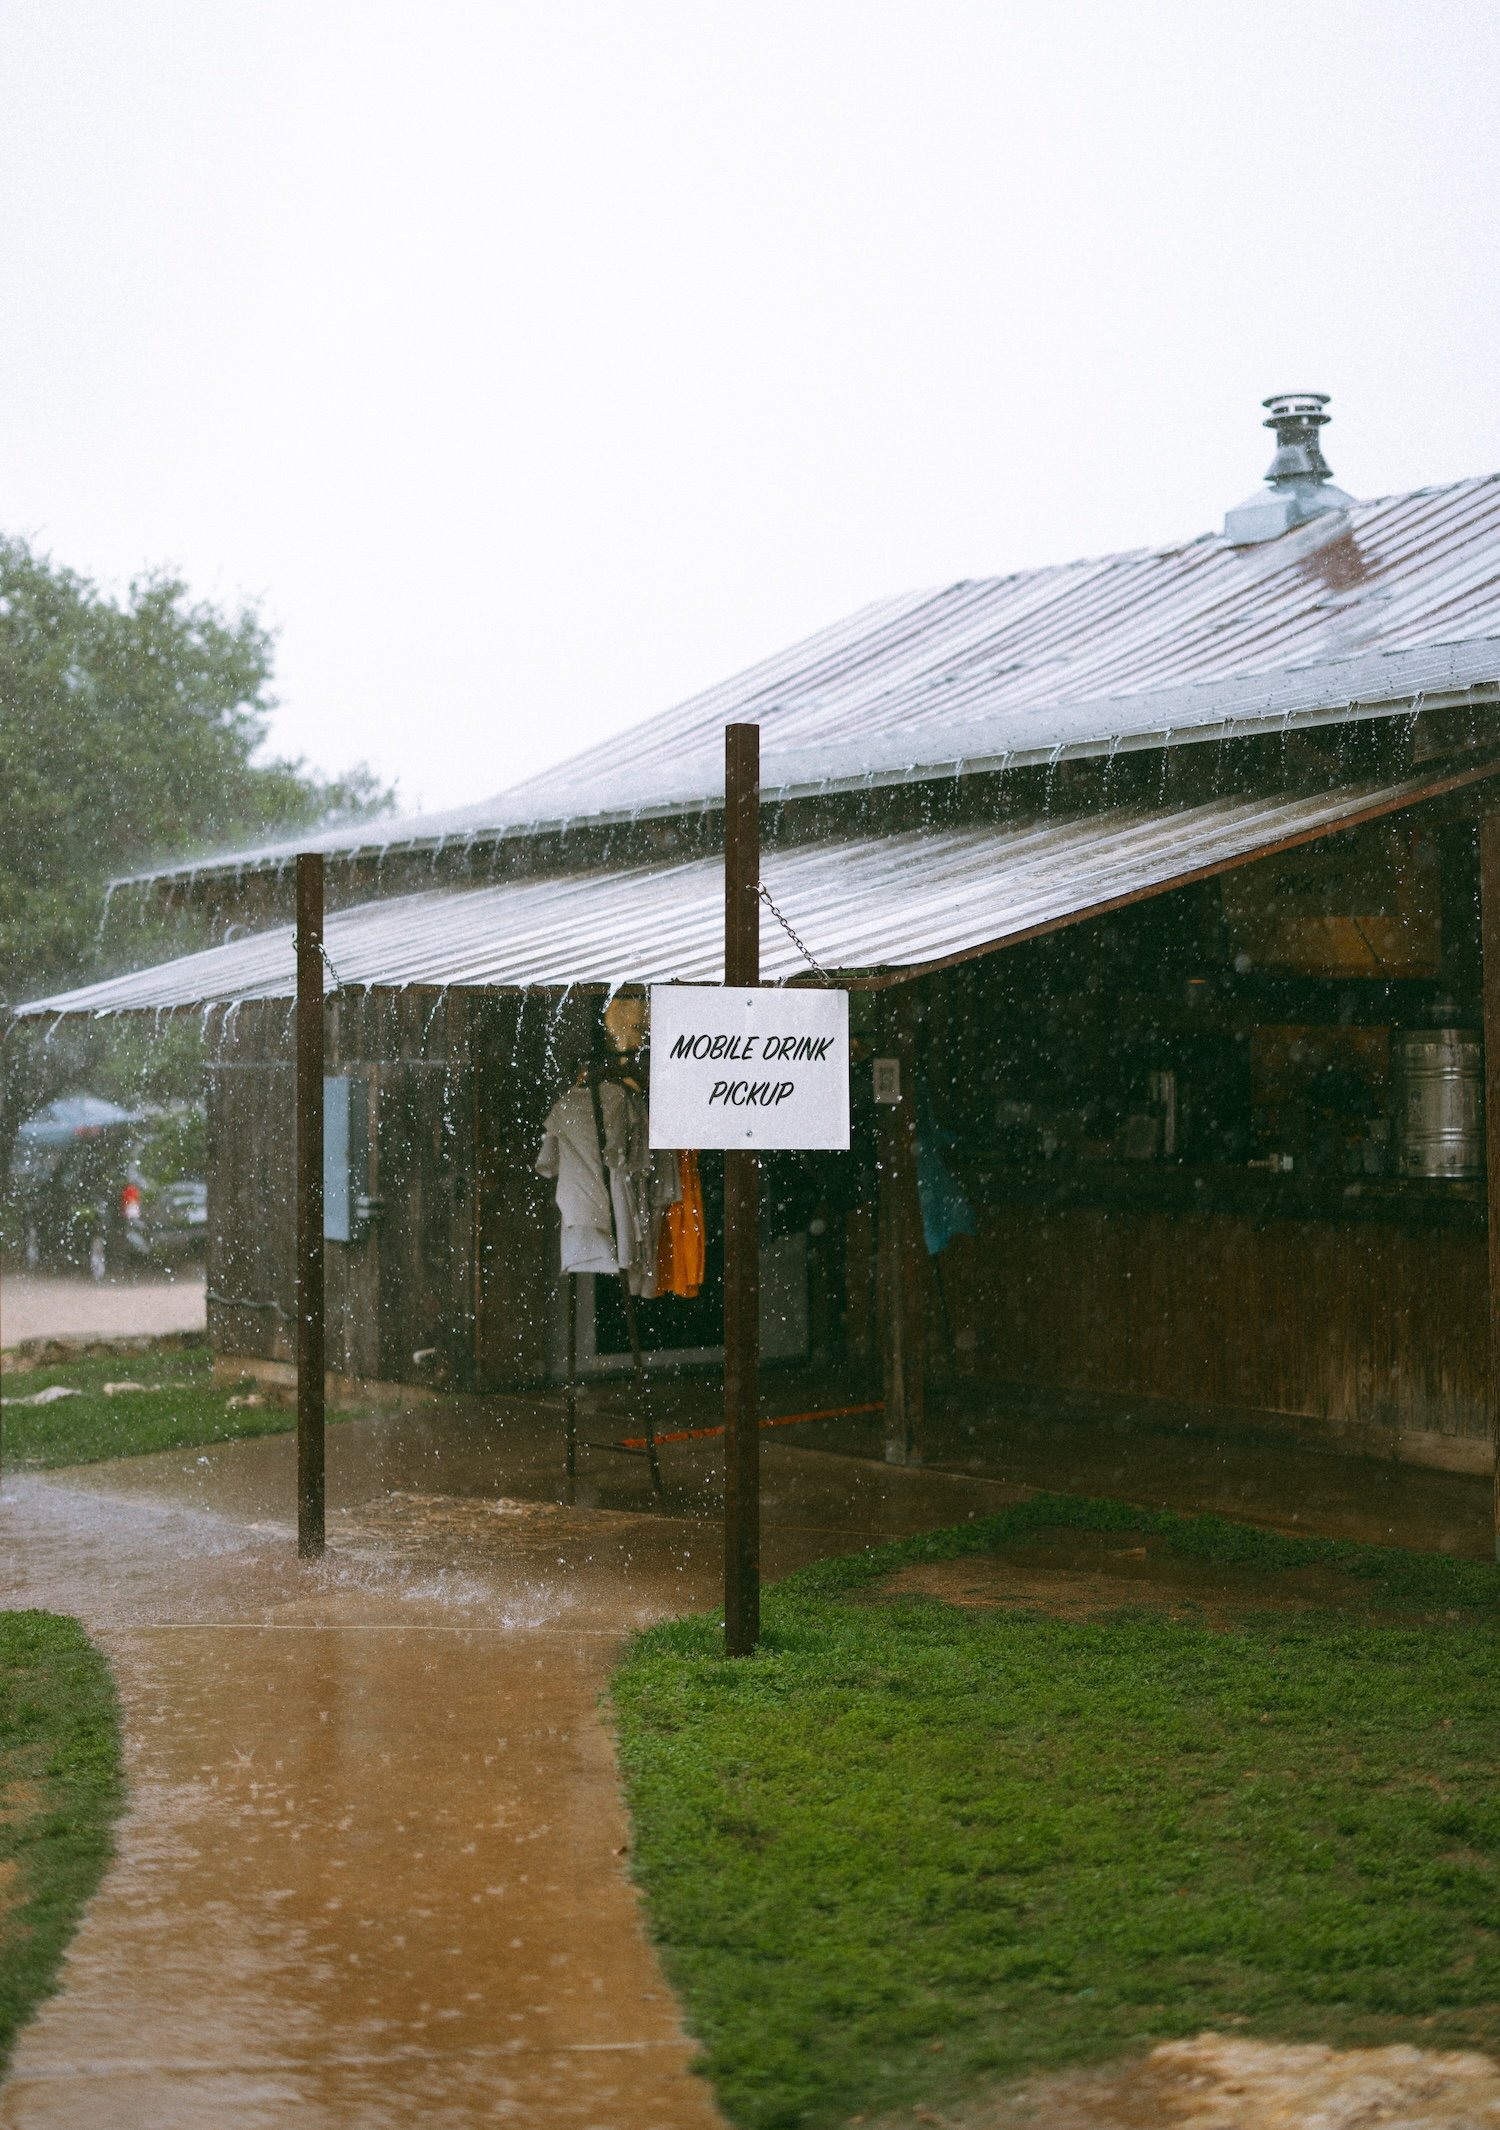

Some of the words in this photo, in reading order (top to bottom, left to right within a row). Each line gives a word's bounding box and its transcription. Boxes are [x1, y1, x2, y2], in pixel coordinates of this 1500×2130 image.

[670, 1034, 760, 1060] MOBILE
[762, 1036, 835, 1061] DRINK
[708, 1080, 795, 1106] PICKUP
